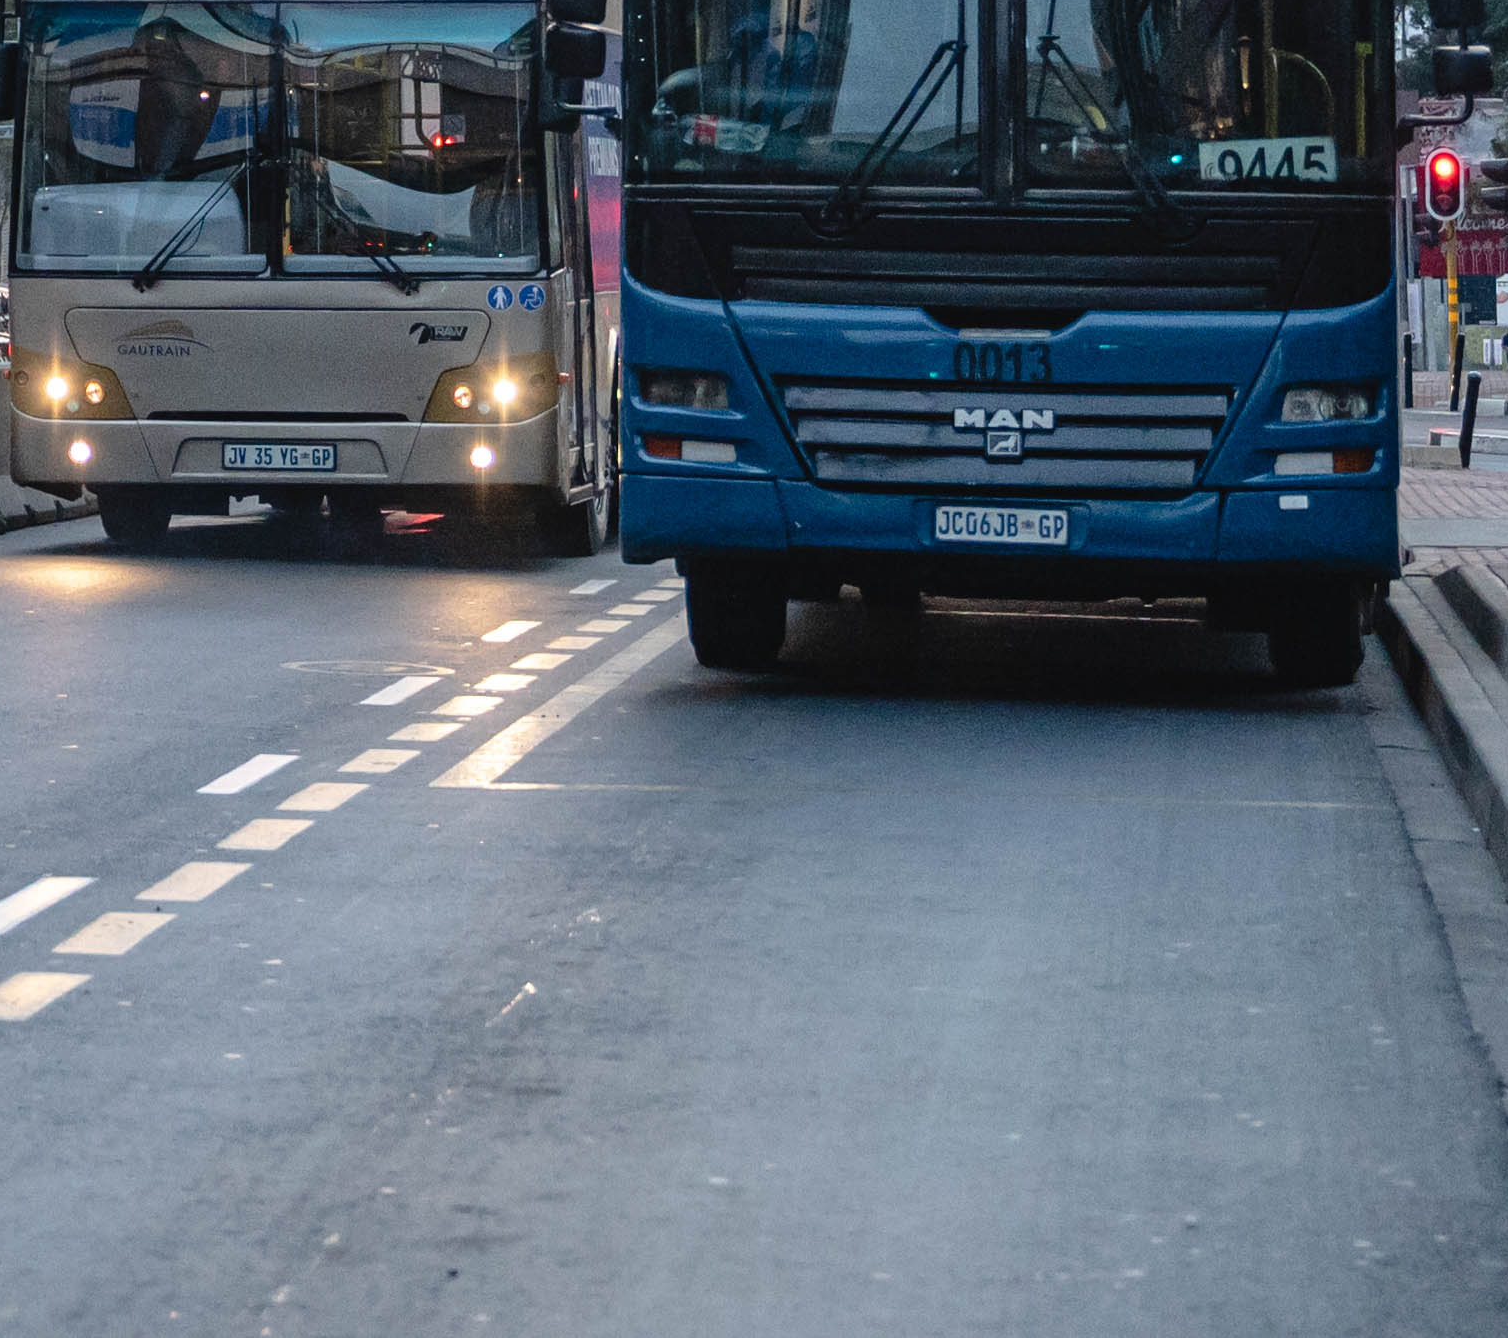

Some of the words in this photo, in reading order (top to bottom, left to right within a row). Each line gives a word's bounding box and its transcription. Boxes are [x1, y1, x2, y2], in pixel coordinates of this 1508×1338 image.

[117, 344, 191, 357] GAUTRAIN
[954, 341, 1052, 381] 0013
[953, 407, 1055, 429] MAN
[228, 448, 246, 465] JV
[254, 448, 272, 465] 35
[281, 448, 299, 465] YG
[312, 449, 331, 466] GP
[1038, 514, 1064, 539] GP
